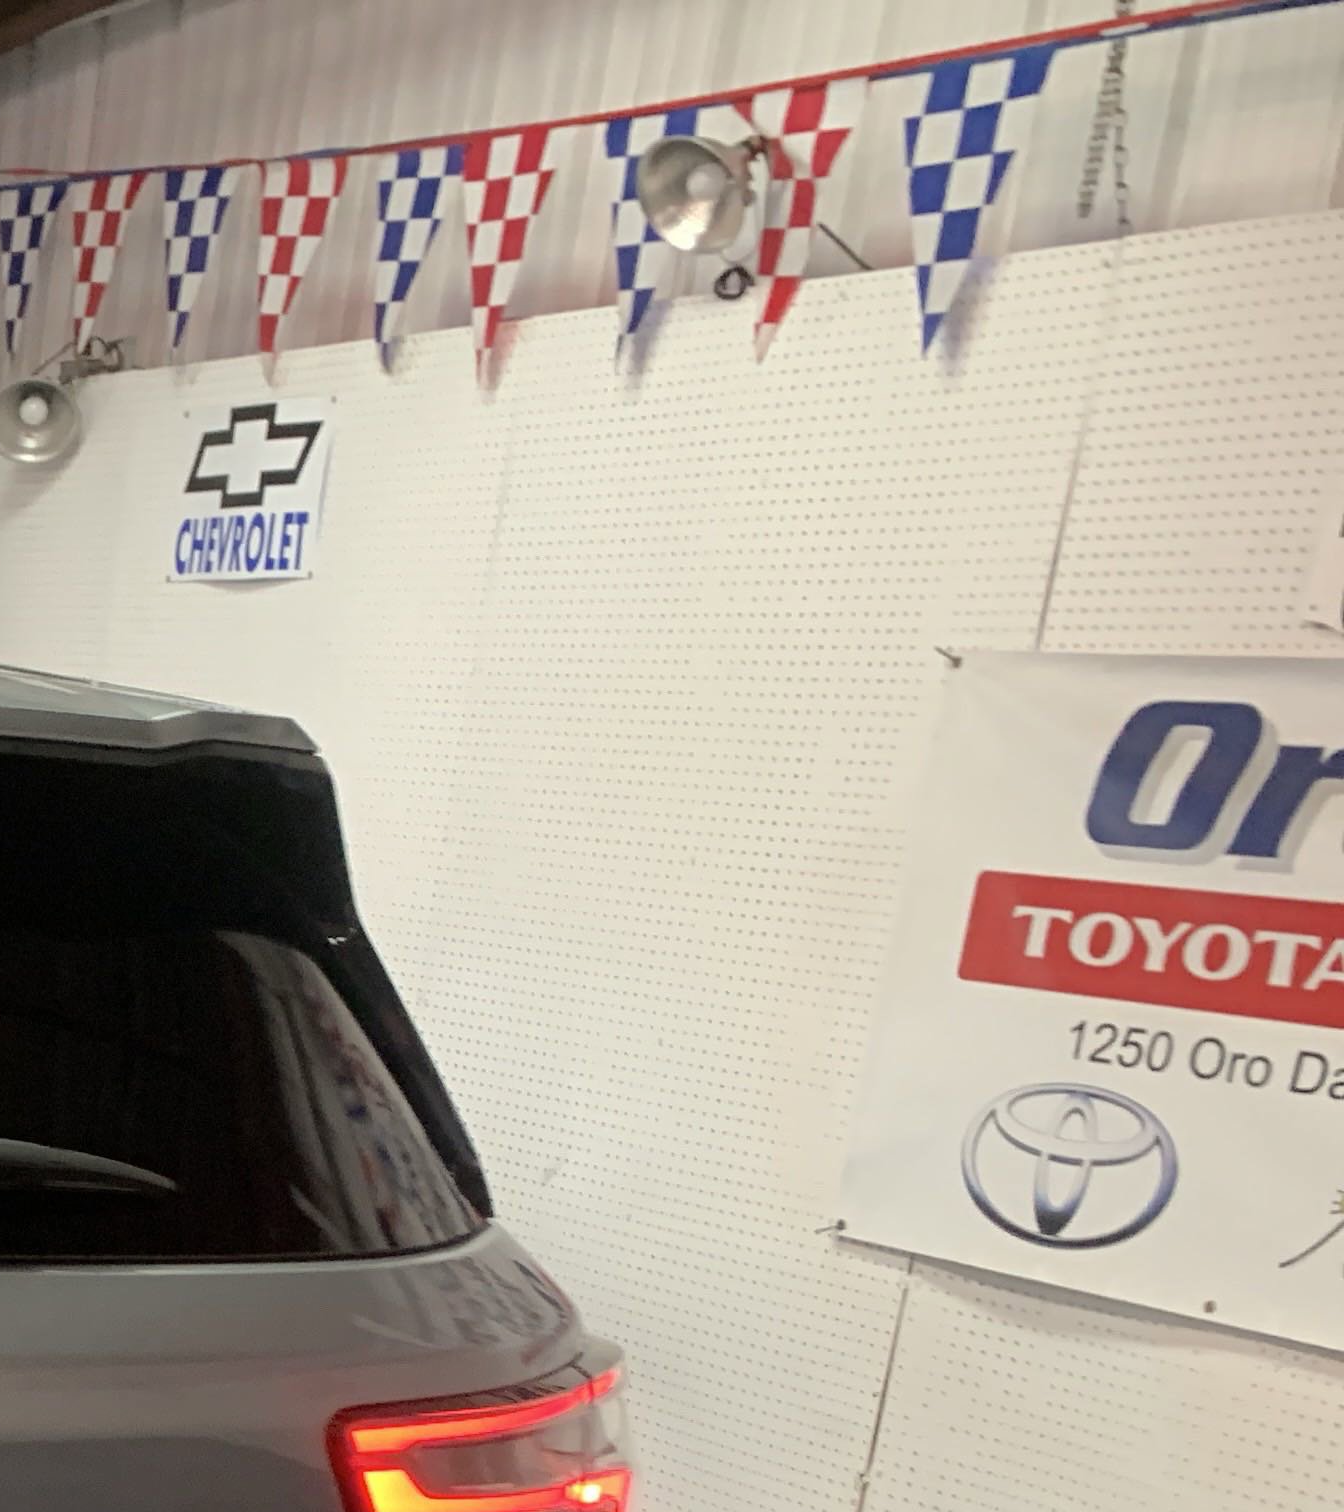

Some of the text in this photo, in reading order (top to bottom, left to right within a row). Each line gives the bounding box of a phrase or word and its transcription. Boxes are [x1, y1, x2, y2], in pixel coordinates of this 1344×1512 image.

[174, 511, 309, 575] CHEVROLET
[1068, 1020, 1174, 1073] 1250
[1188, 1037, 1273, 1088] Oro
